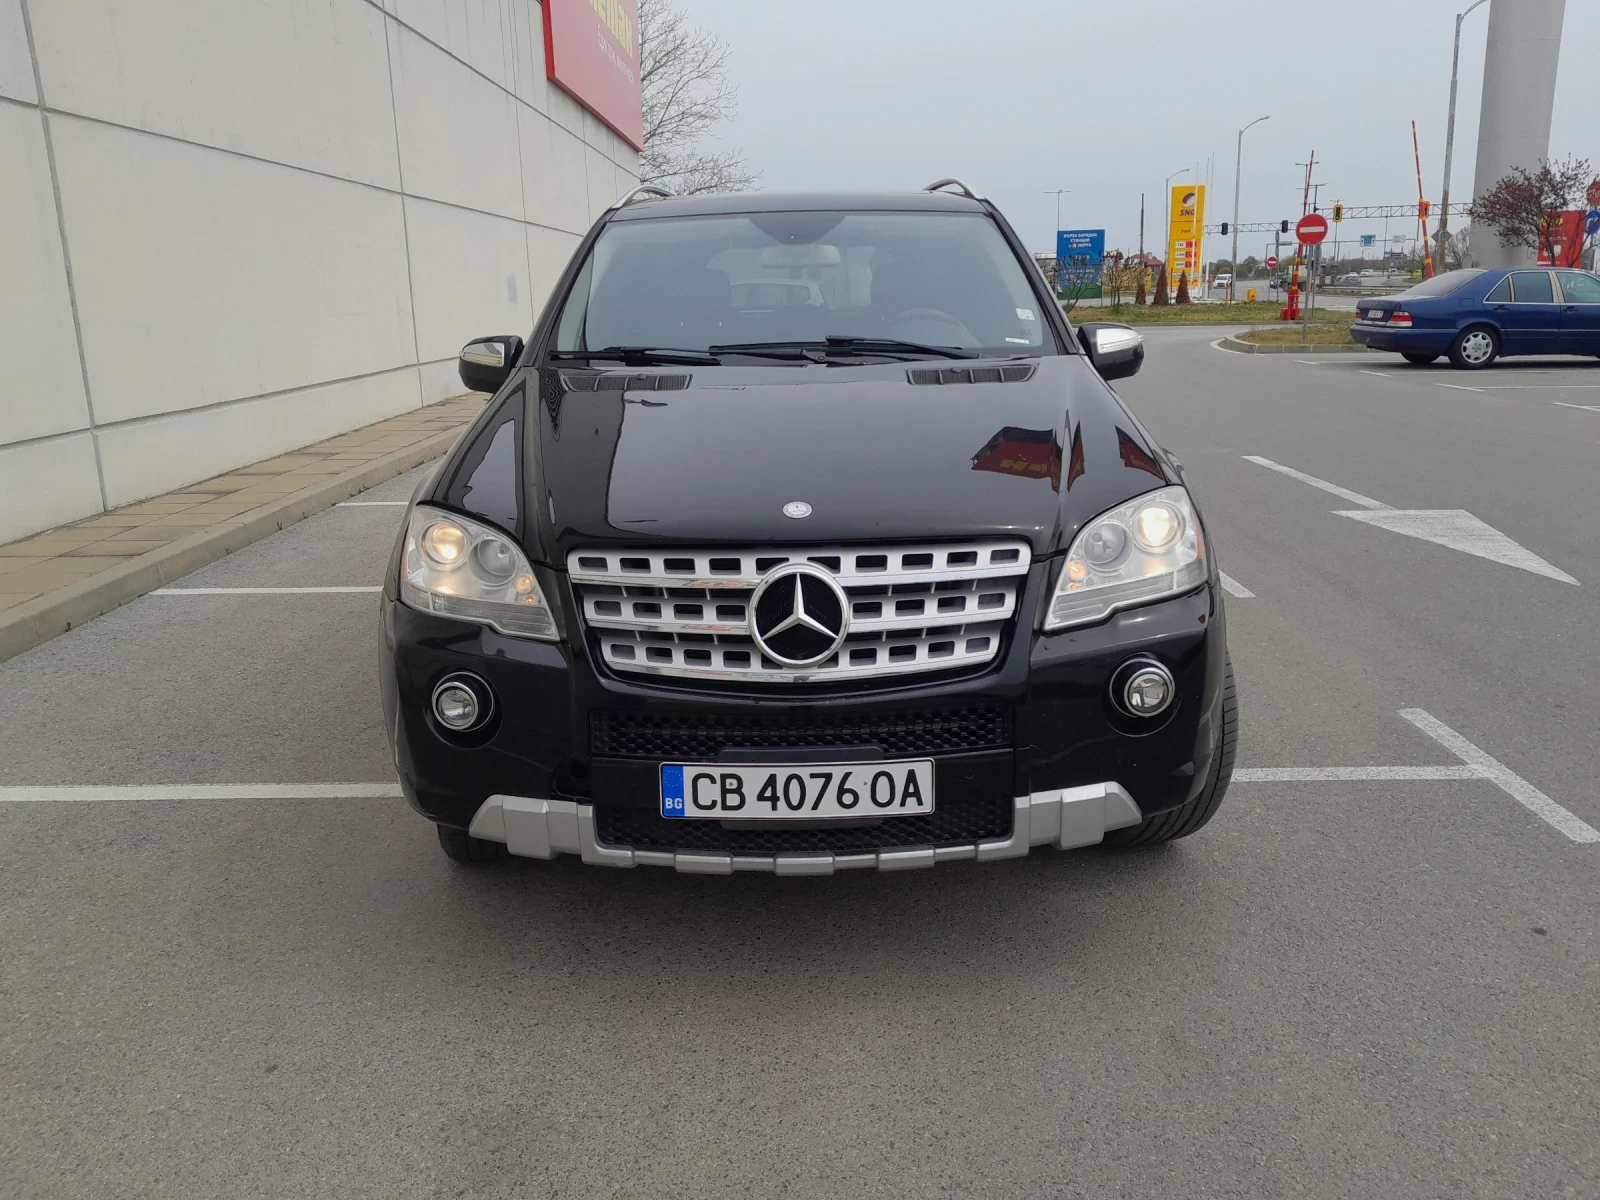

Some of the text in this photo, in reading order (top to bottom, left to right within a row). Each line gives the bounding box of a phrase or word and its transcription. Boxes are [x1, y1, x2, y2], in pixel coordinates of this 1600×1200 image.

[665, 797, 683, 809] BG
[691, 768, 924, 811] CB 4076 OA
